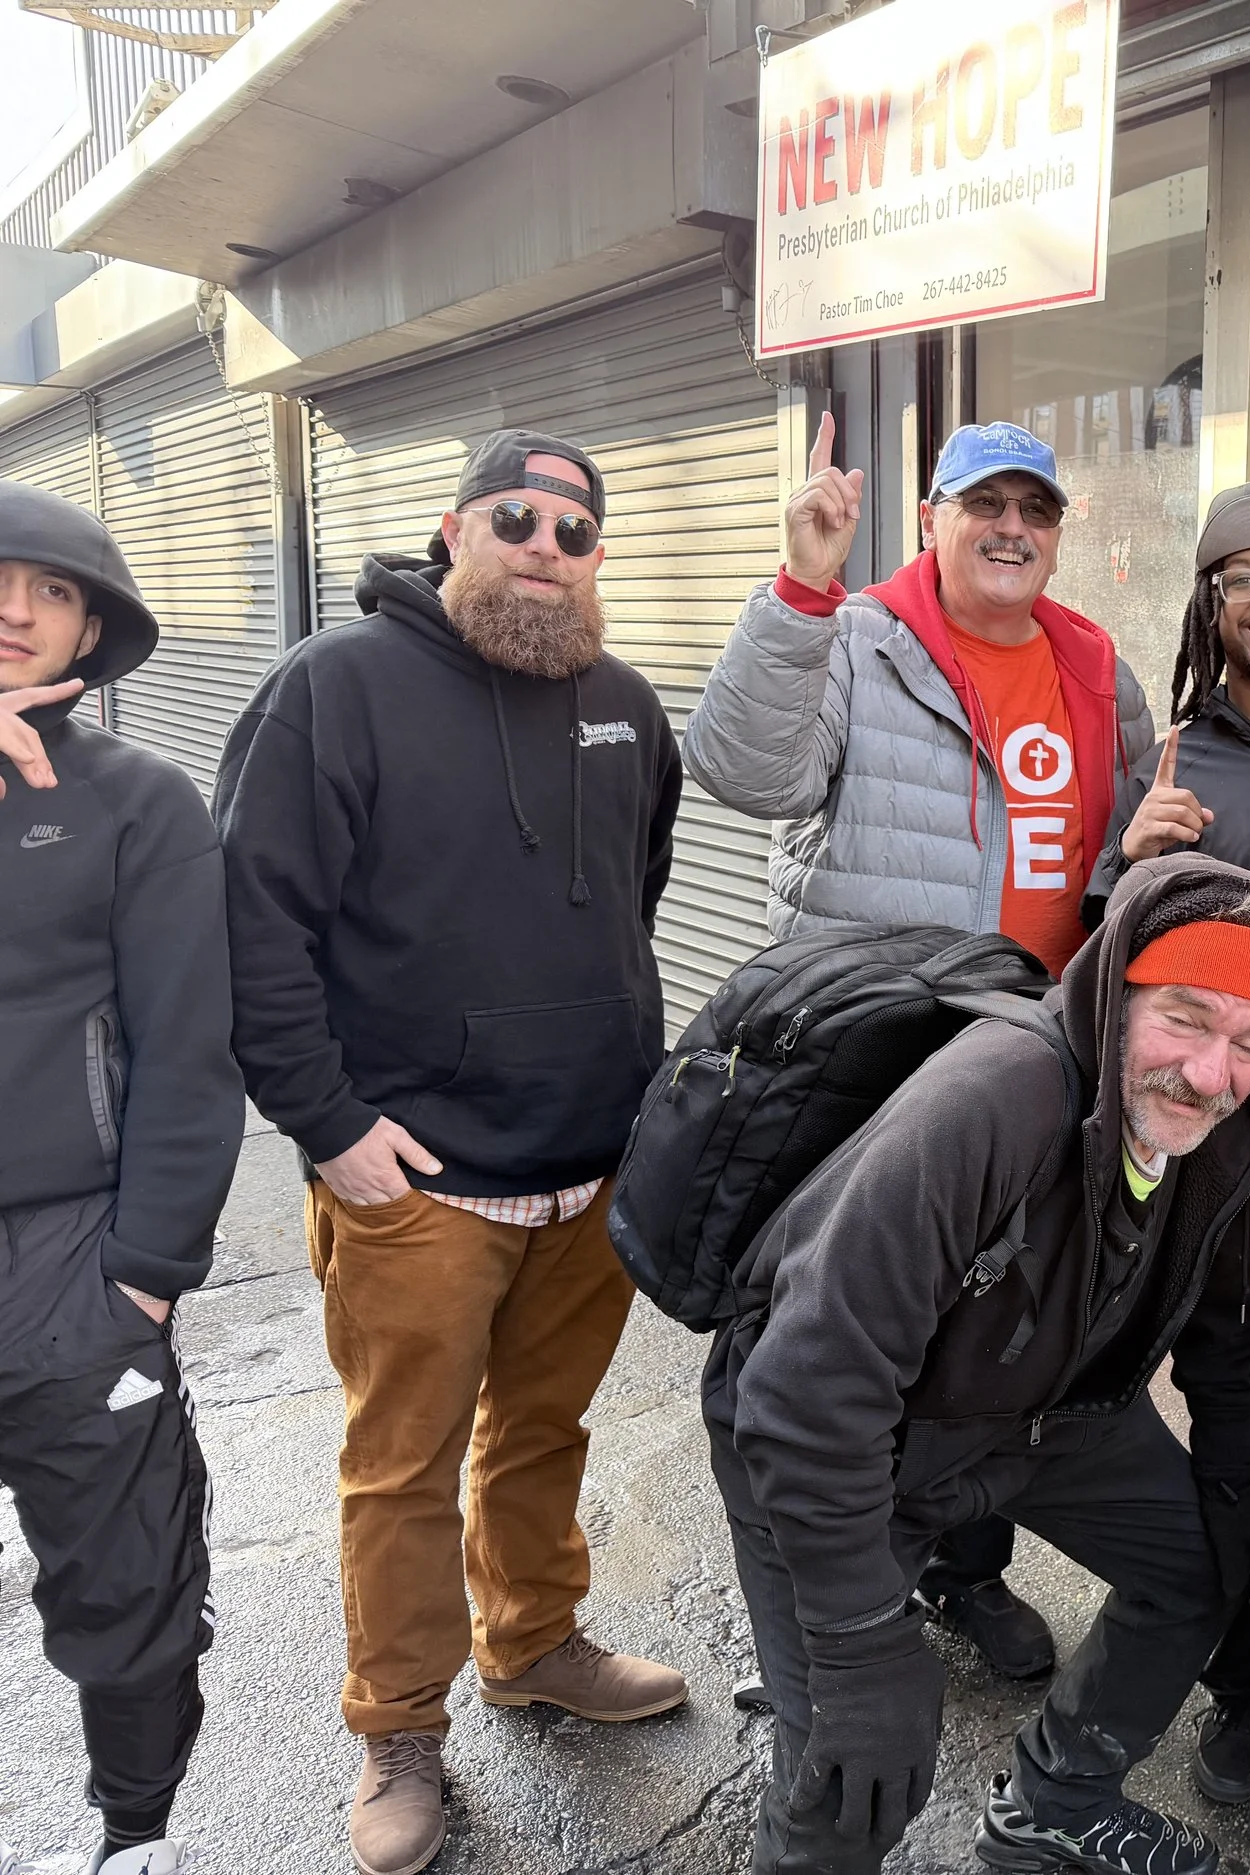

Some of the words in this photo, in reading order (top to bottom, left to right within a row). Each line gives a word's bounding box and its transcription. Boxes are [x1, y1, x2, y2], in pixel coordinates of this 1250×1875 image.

[777, 90, 891, 216] NEW
[910, 1, 1088, 176] HOPE
[778, 214, 868, 261] Presbyterian
[872, 189, 930, 237] Church
[936, 187, 952, 219] of
[957, 155, 1075, 214] Philadelphia
[819, 298, 852, 321] Pastor
[853, 294, 873, 314] Tim
[875, 290, 904, 310] Choe
[922, 266, 1008, 302] 267-442-8425
[28, 824, 64, 840] NIKE
[110, 1383, 159, 1408] adidas
